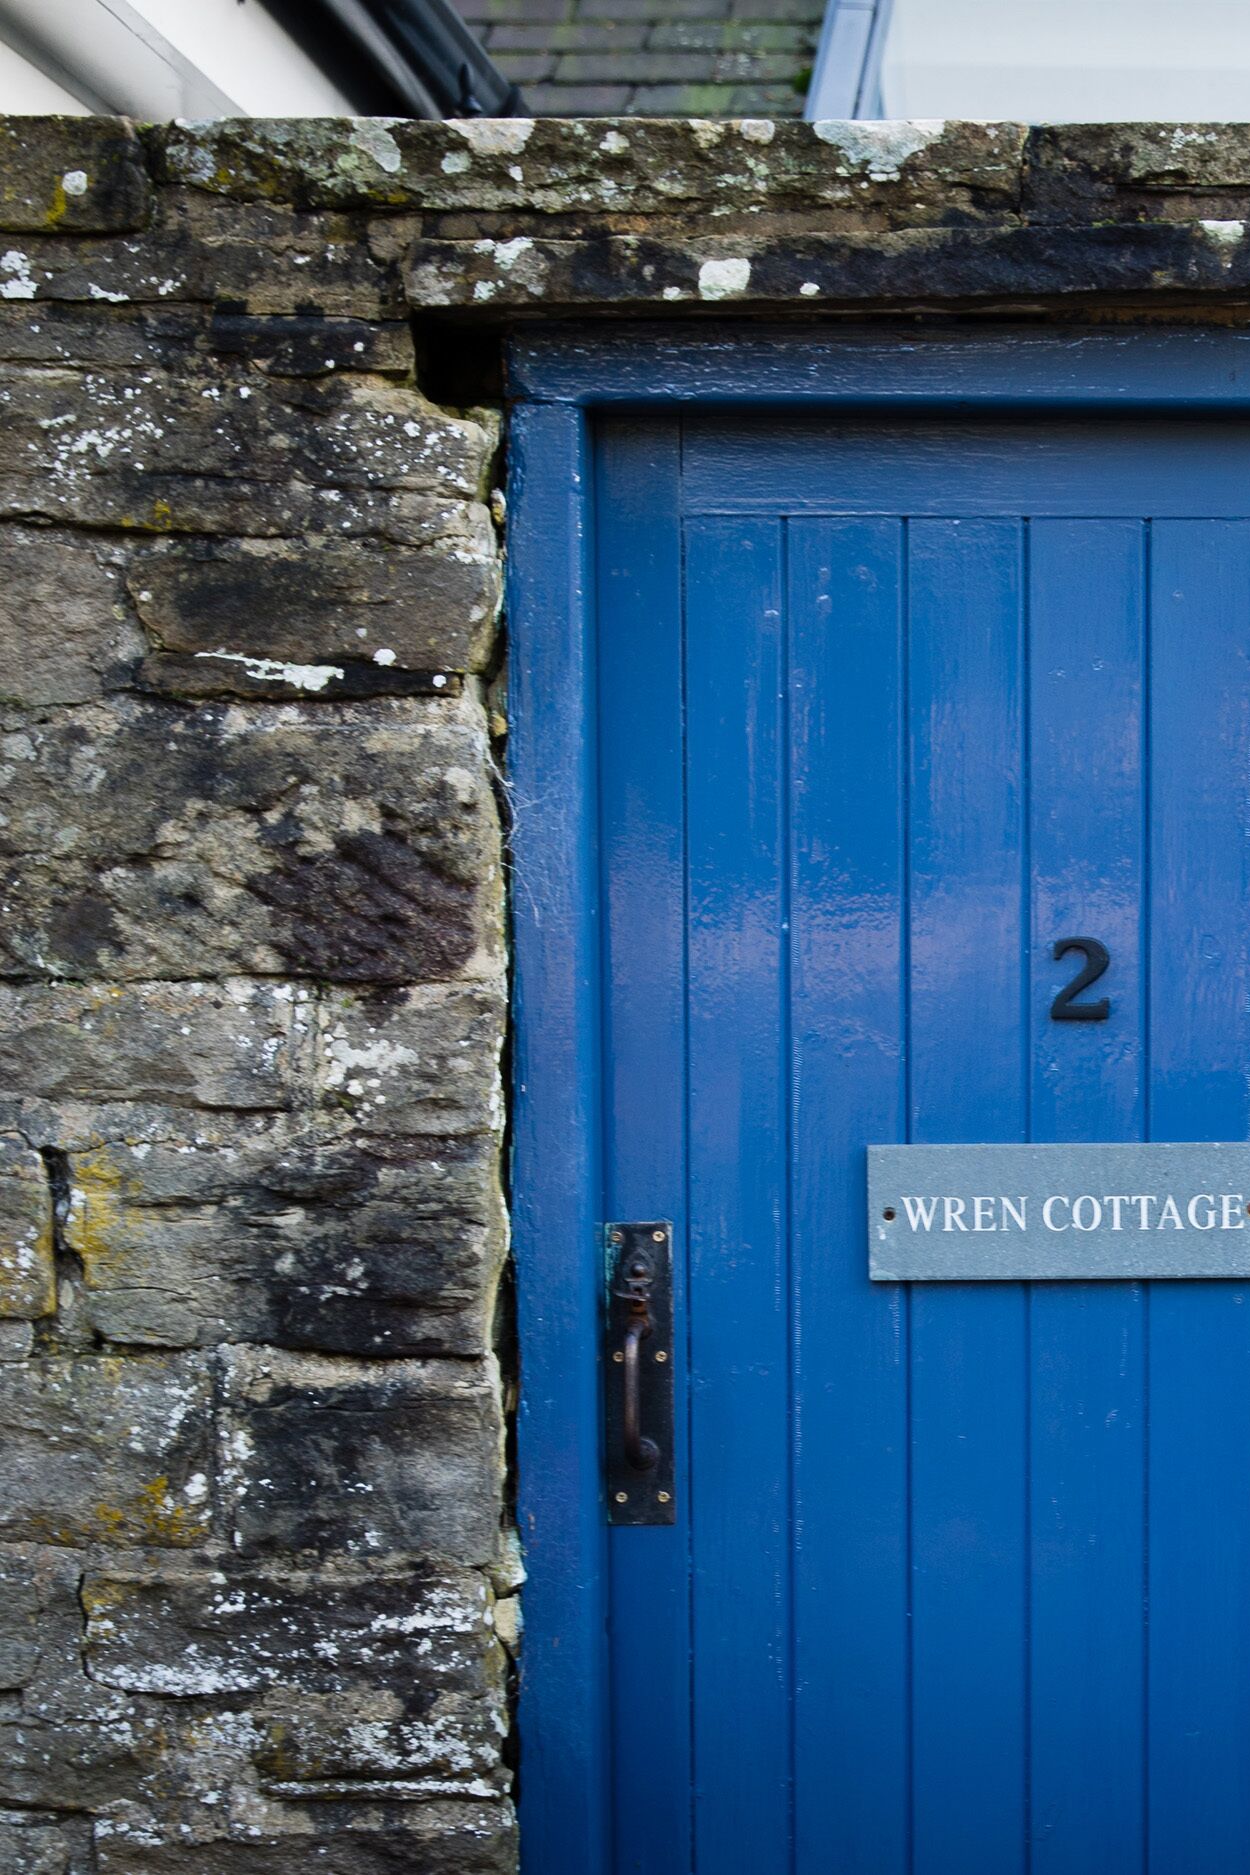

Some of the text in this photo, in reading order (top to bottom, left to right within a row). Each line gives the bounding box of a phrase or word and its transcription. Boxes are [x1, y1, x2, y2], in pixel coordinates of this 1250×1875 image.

[1050, 936, 1110, 1020] 2
[901, 1193, 1245, 1232] WREN COTTAGE
